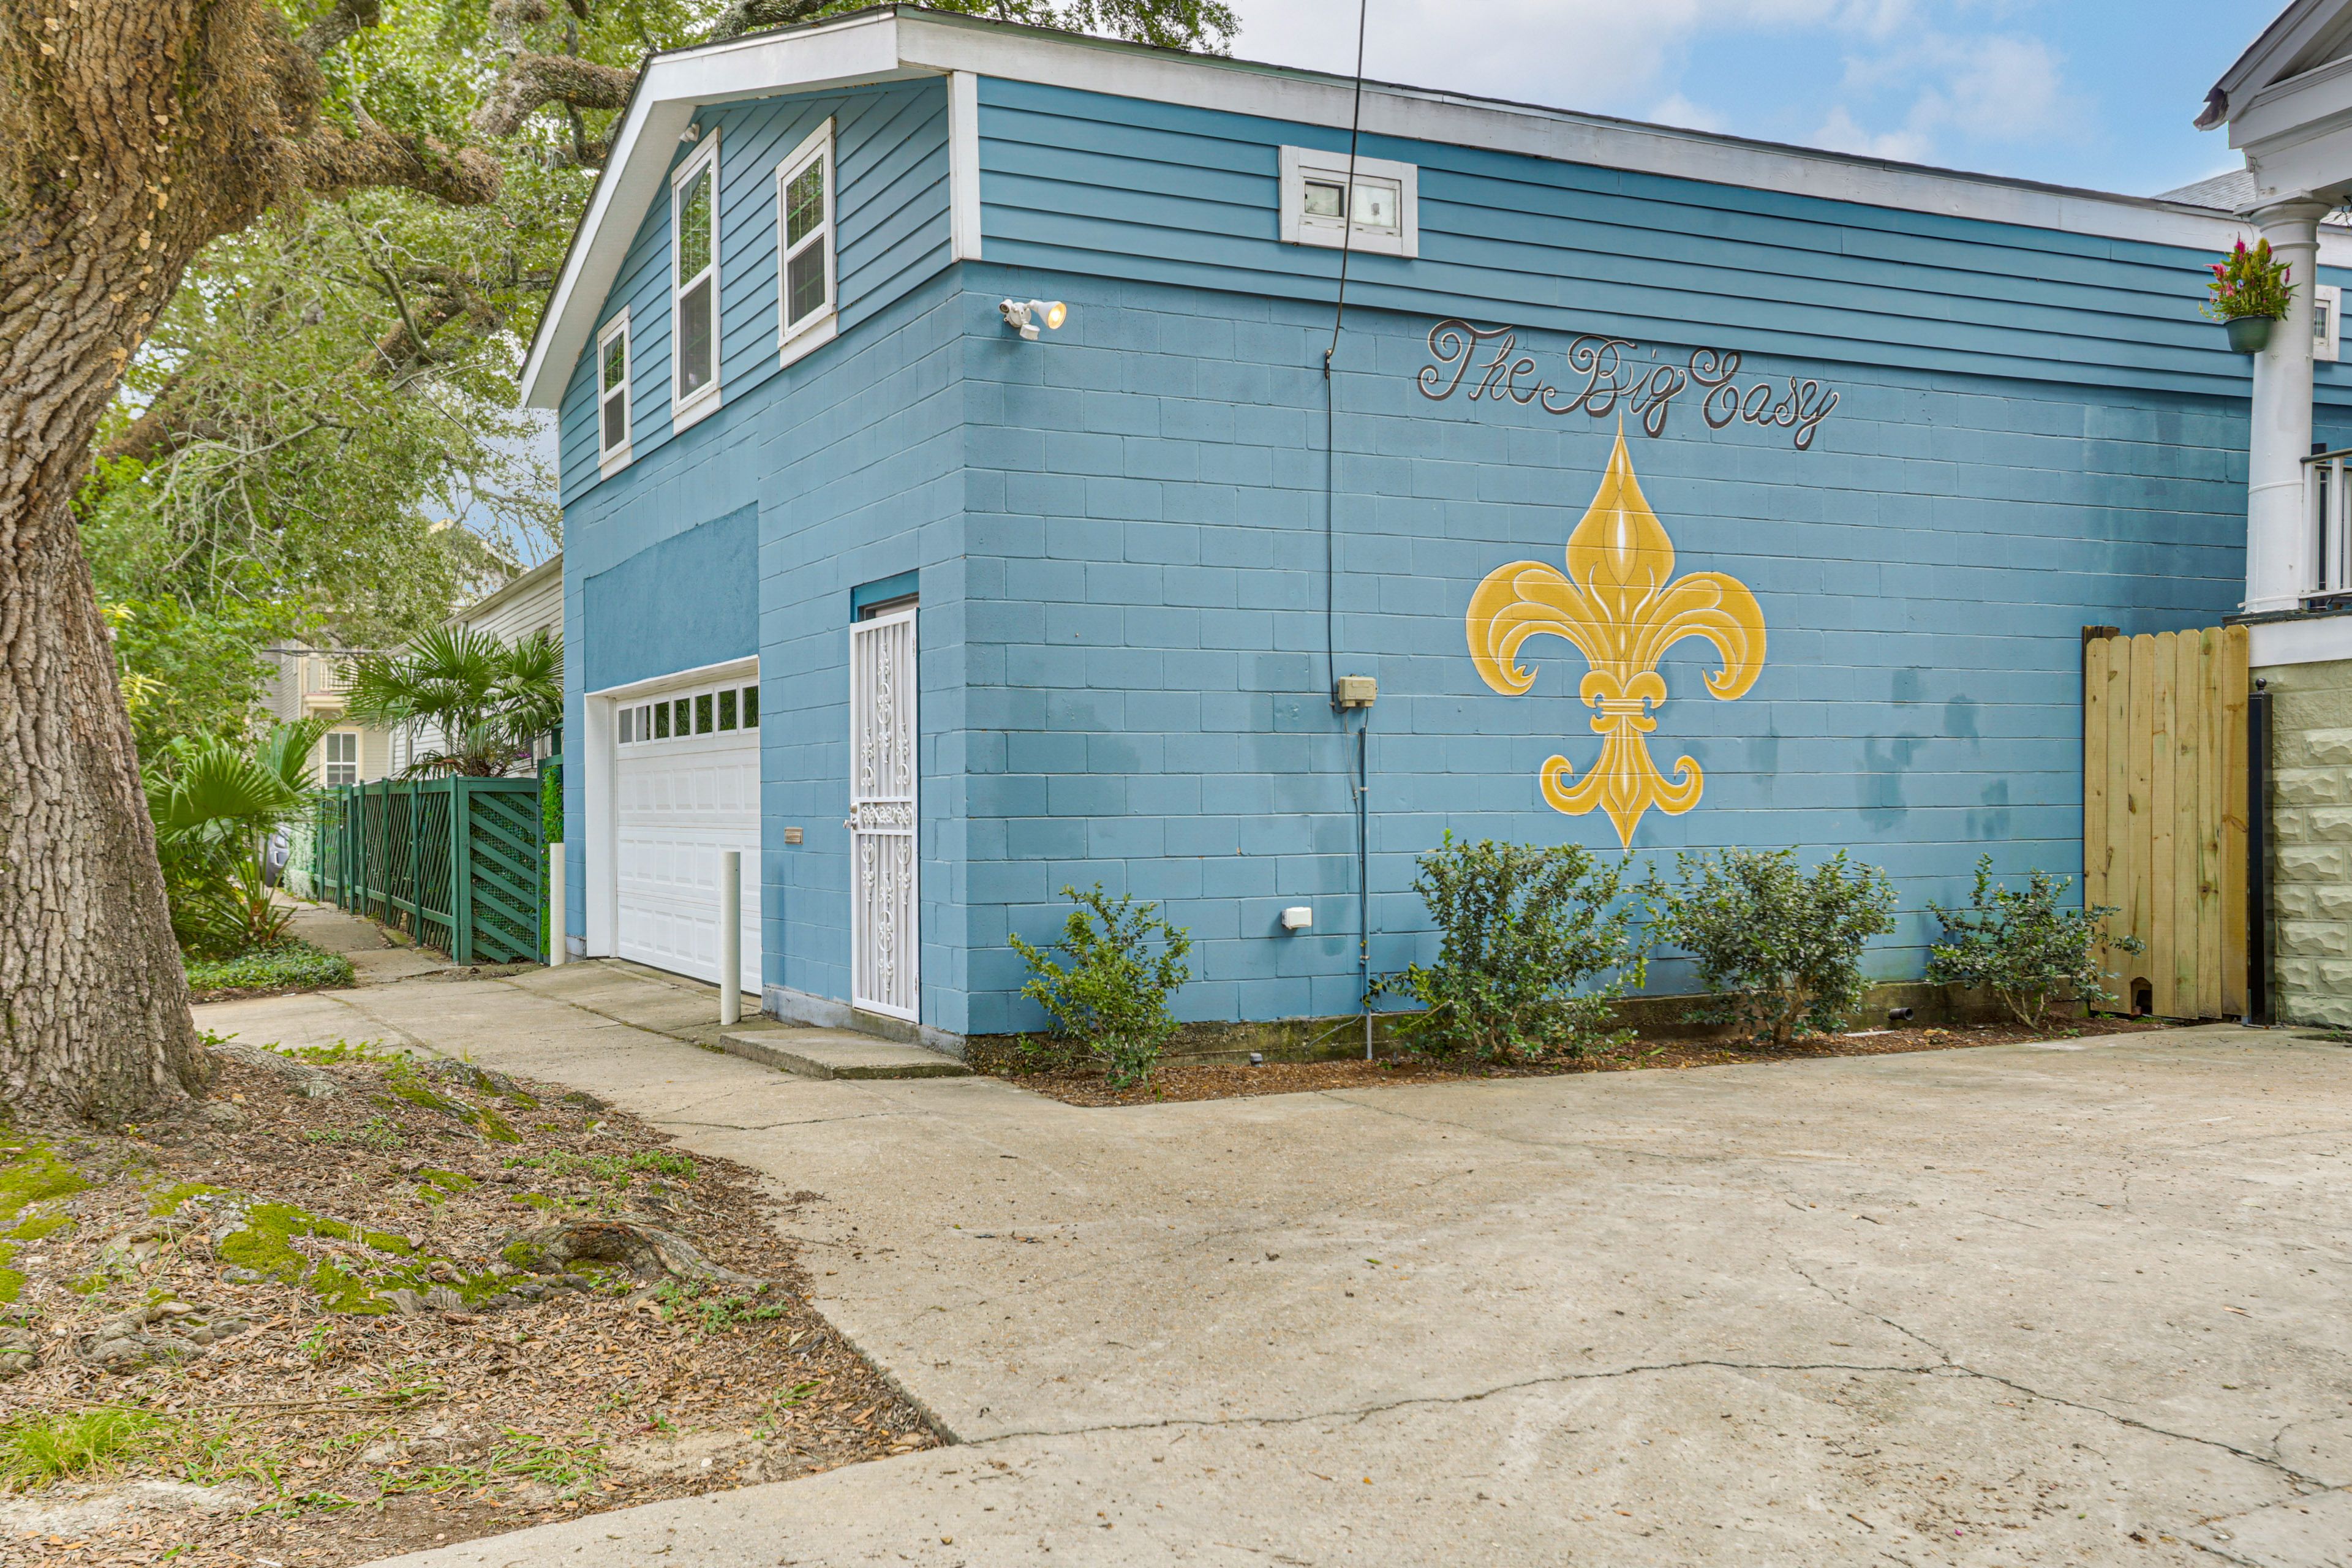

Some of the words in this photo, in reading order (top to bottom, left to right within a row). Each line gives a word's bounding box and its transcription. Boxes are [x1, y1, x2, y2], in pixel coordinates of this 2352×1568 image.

[1417, 319, 1543, 404] The
[1541, 334, 1687, 438] Big
[1689, 348, 1839, 451] Easy
